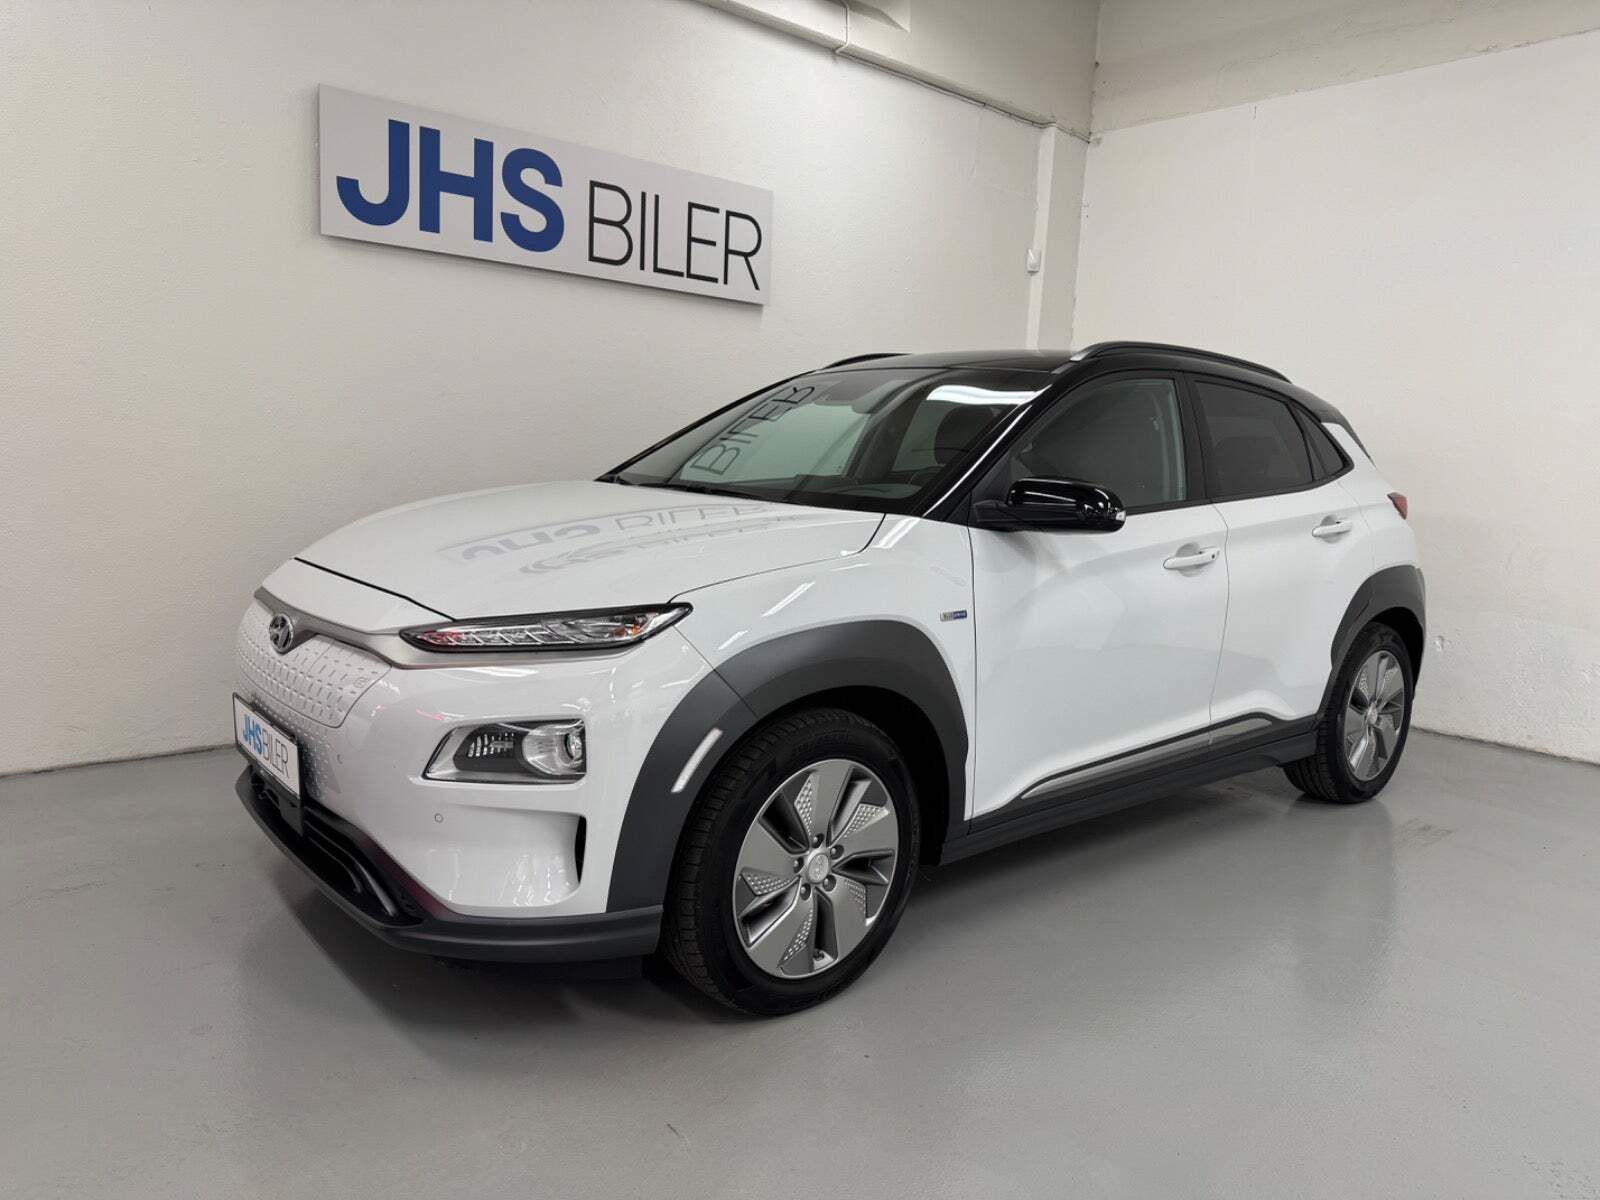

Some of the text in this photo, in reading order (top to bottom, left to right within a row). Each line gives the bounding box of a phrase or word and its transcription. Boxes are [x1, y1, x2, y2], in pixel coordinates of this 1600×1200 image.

[336, 119, 763, 291] JHS BILER
[242, 713, 289, 780] JHS BILER
